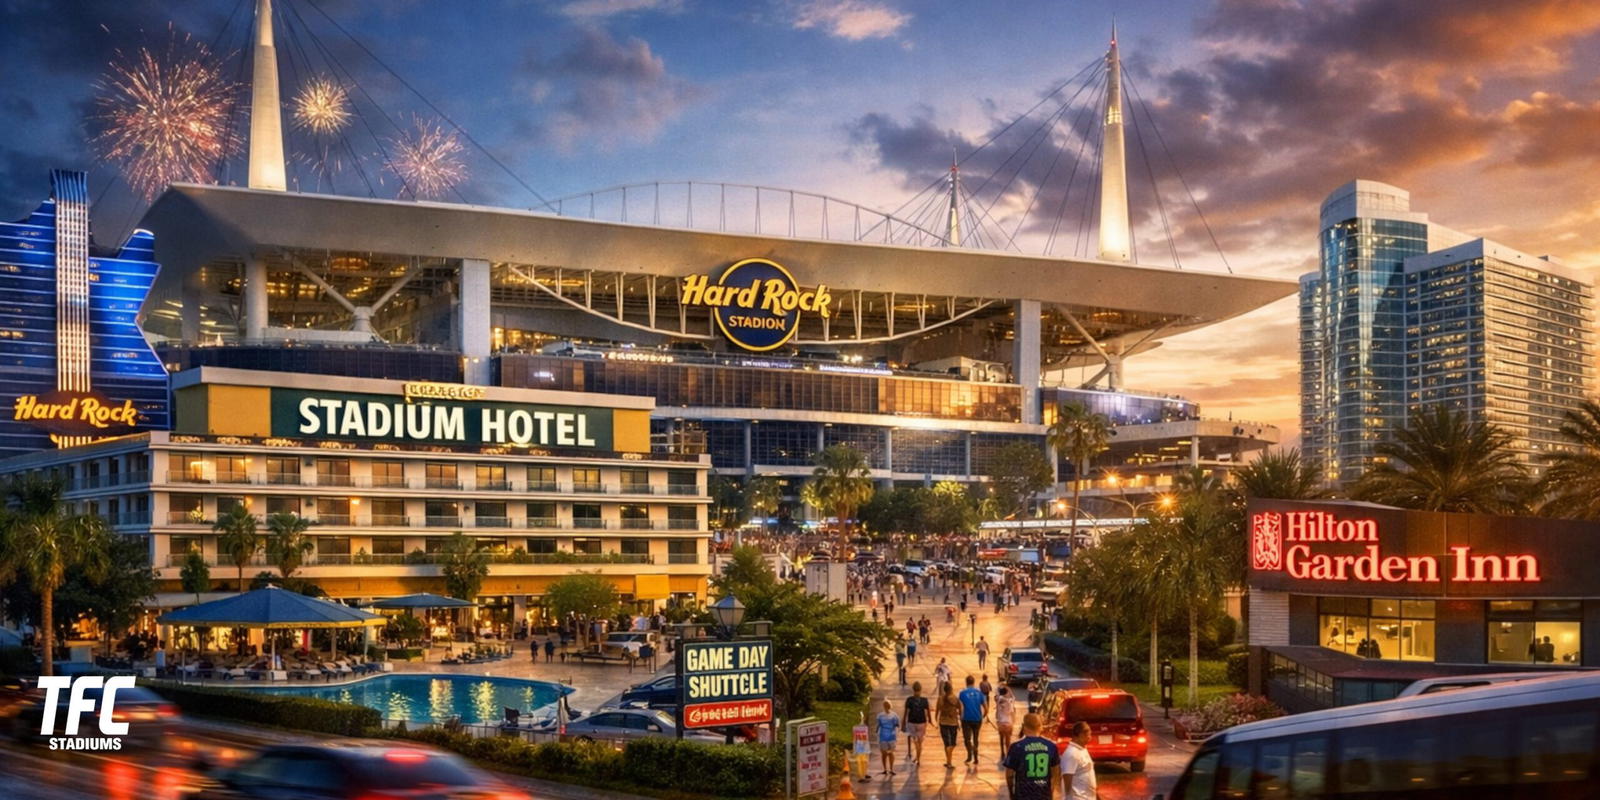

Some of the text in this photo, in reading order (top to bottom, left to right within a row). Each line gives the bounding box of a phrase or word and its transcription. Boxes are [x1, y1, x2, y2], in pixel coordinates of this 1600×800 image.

[681, 274, 832, 319] Hard Rock
[14, 395, 137, 428] Hard Rock
[299, 398, 595, 447] STADIUM HOTEL
[1286, 512, 1379, 542] Hilton
[1286, 544, 1540, 583] Garden Inn
[687, 646, 769, 671] GAME DAY
